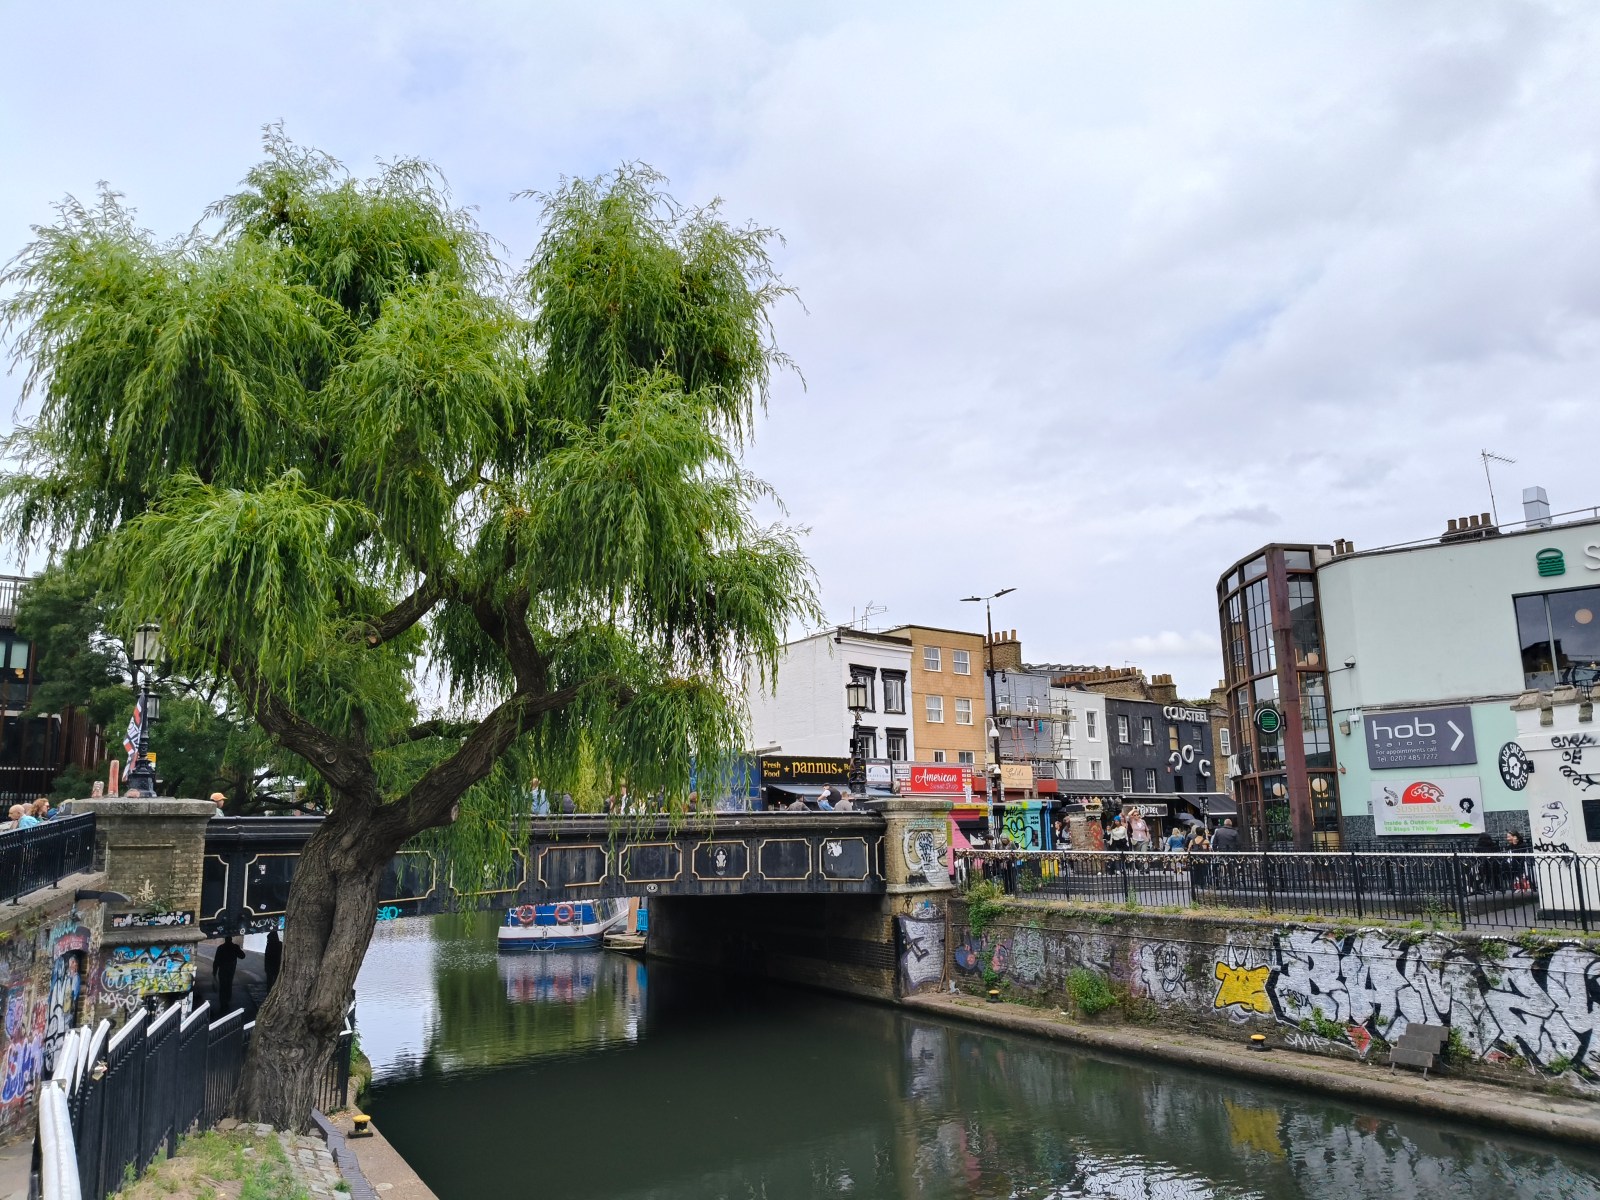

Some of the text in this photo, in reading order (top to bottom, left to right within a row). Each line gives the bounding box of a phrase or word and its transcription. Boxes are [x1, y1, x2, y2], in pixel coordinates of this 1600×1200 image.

[1186, 710, 1208, 723] STEEL
[1372, 717, 1436, 740] hob
[1374, 740, 1437, 748] salons
[1386, 747, 1426, 755] appointments
[1501, 743, 1526, 772] BLACK SHEEP
[763, 760, 781, 769] Fresh
[791, 761, 838, 777] pannus
[763, 770, 780, 778] Food
[914, 768, 957, 787] American
[1510, 770, 1528, 789] COFFEE
[1396, 805, 1423, 813] SUSHI
